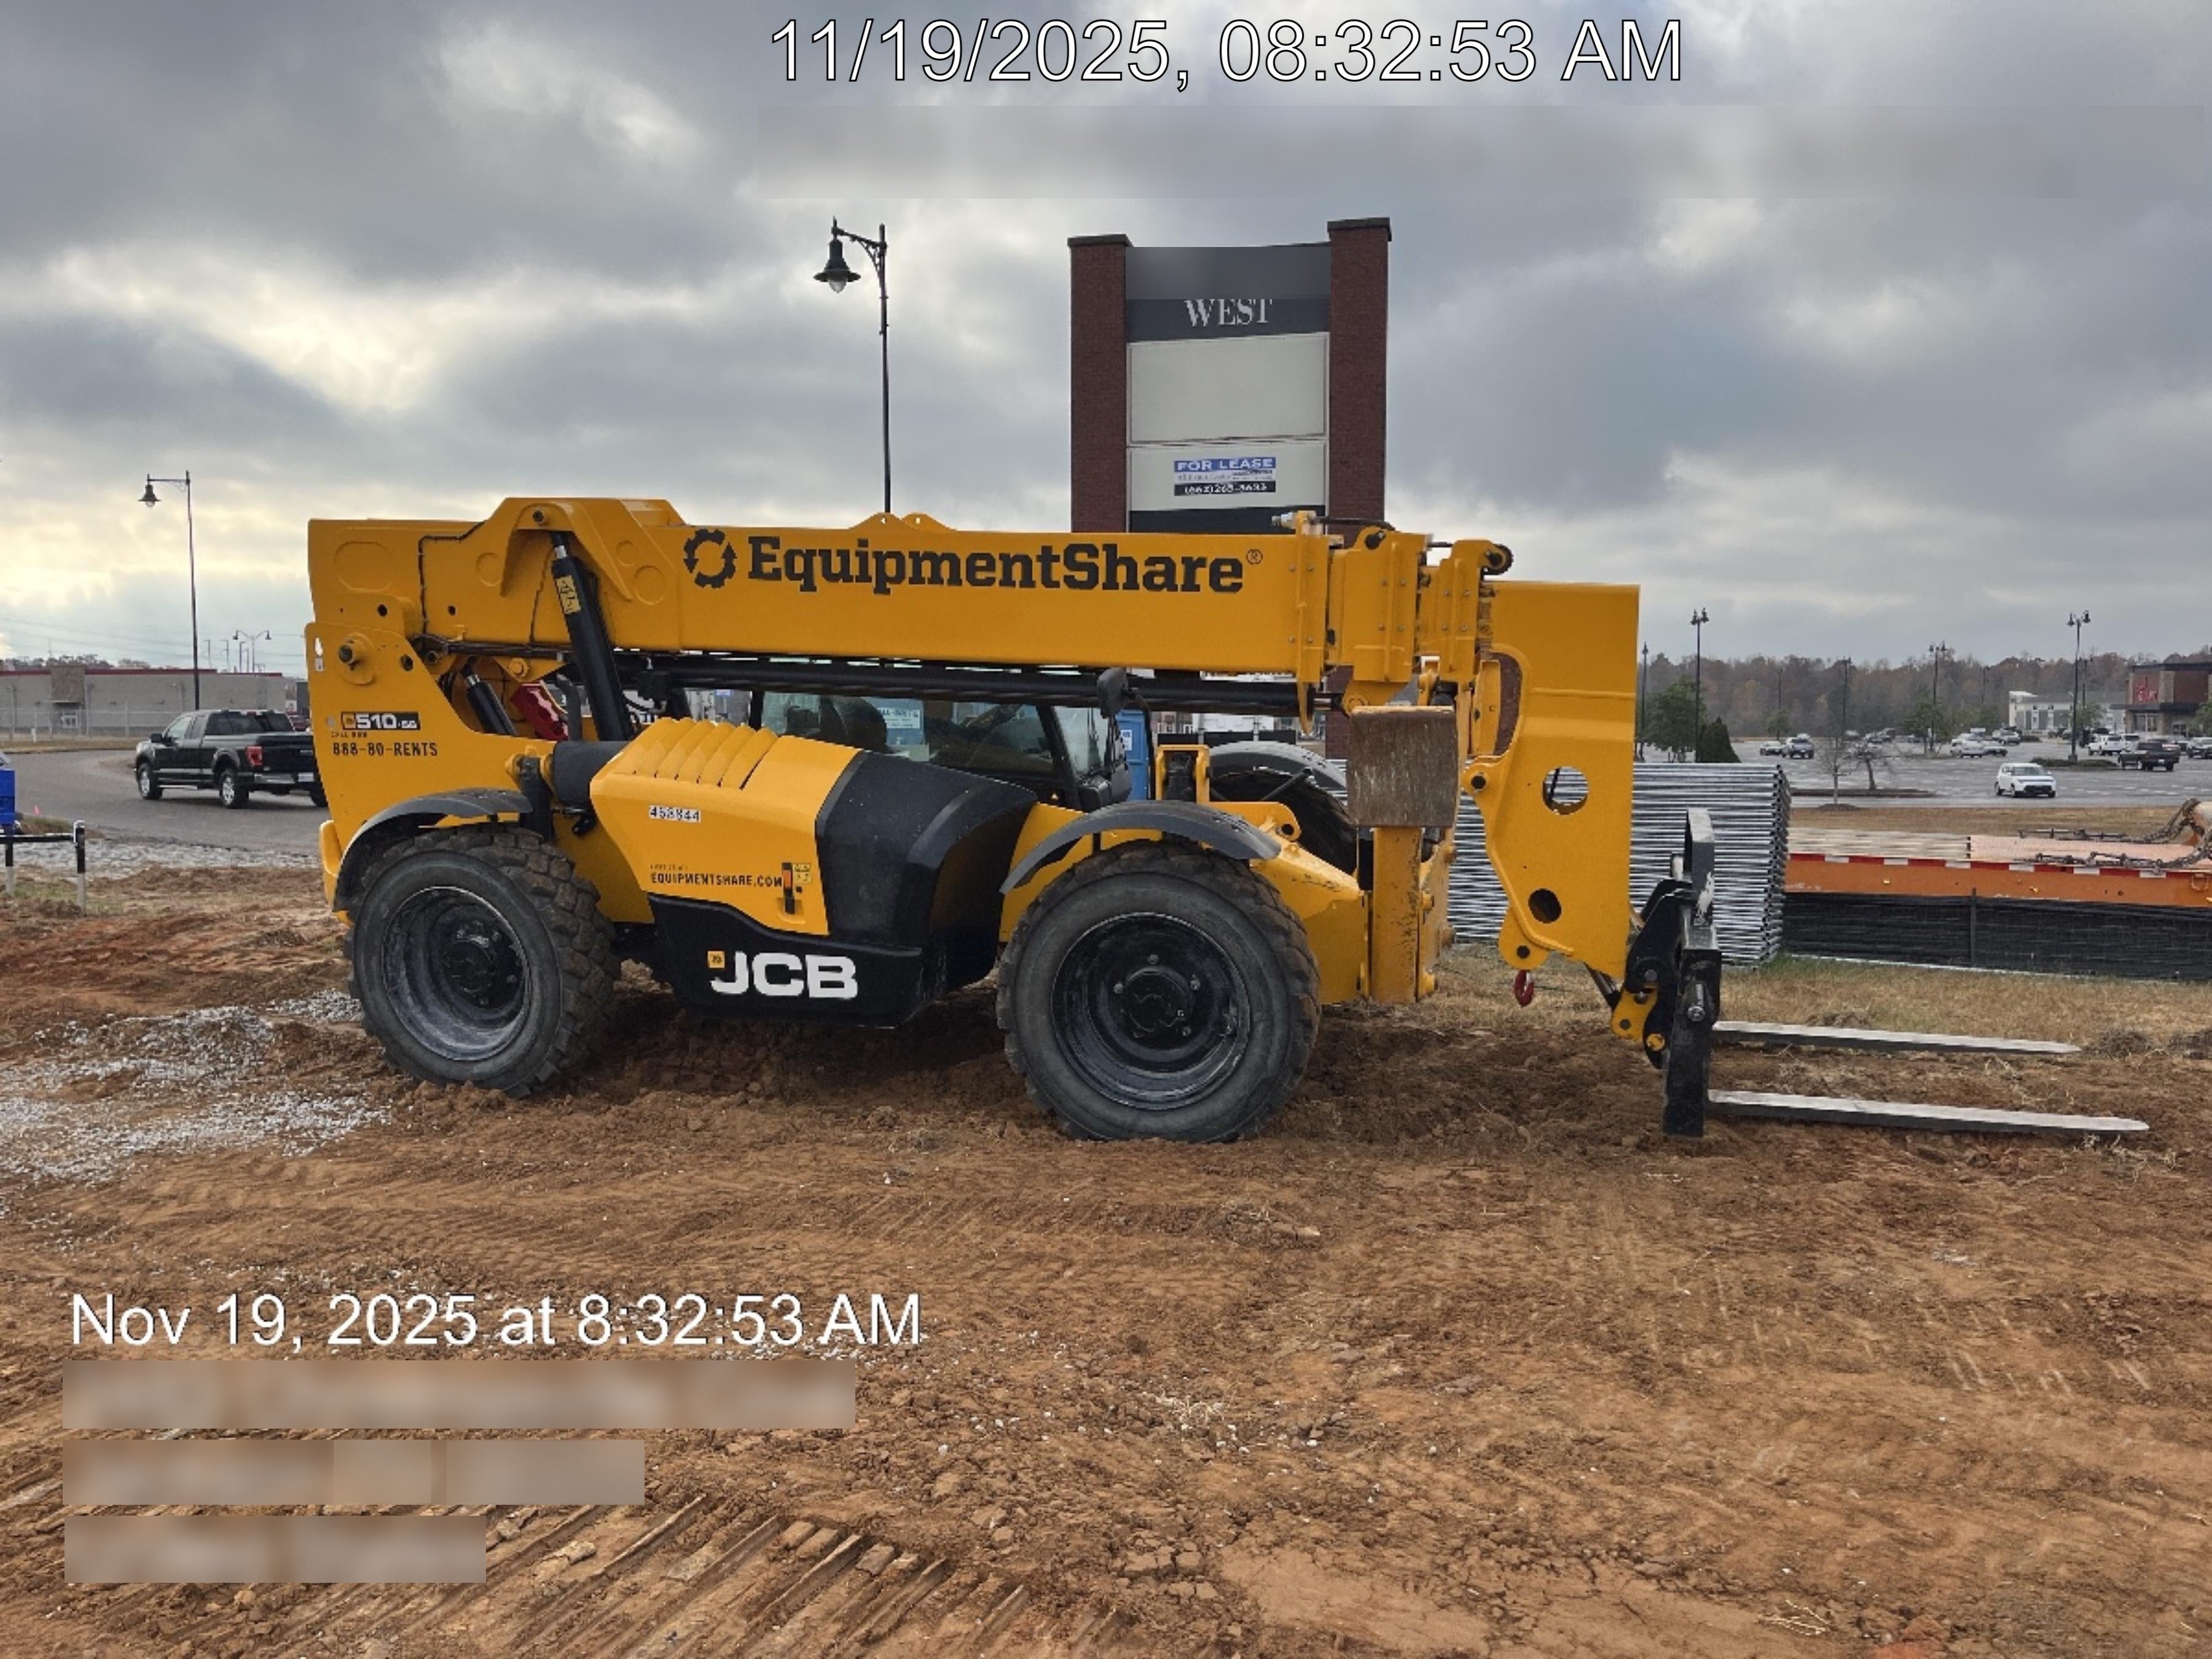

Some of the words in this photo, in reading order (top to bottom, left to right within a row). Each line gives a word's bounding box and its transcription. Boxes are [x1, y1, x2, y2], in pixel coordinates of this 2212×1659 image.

[1183, 299, 1273, 327] WEST
[1177, 461, 1212, 471] FOR
[1220, 458, 1273, 469] LEASE
[651, 873, 783, 887] EQUIPMENTSHARE.COM
[710, 951, 858, 999] JCB
